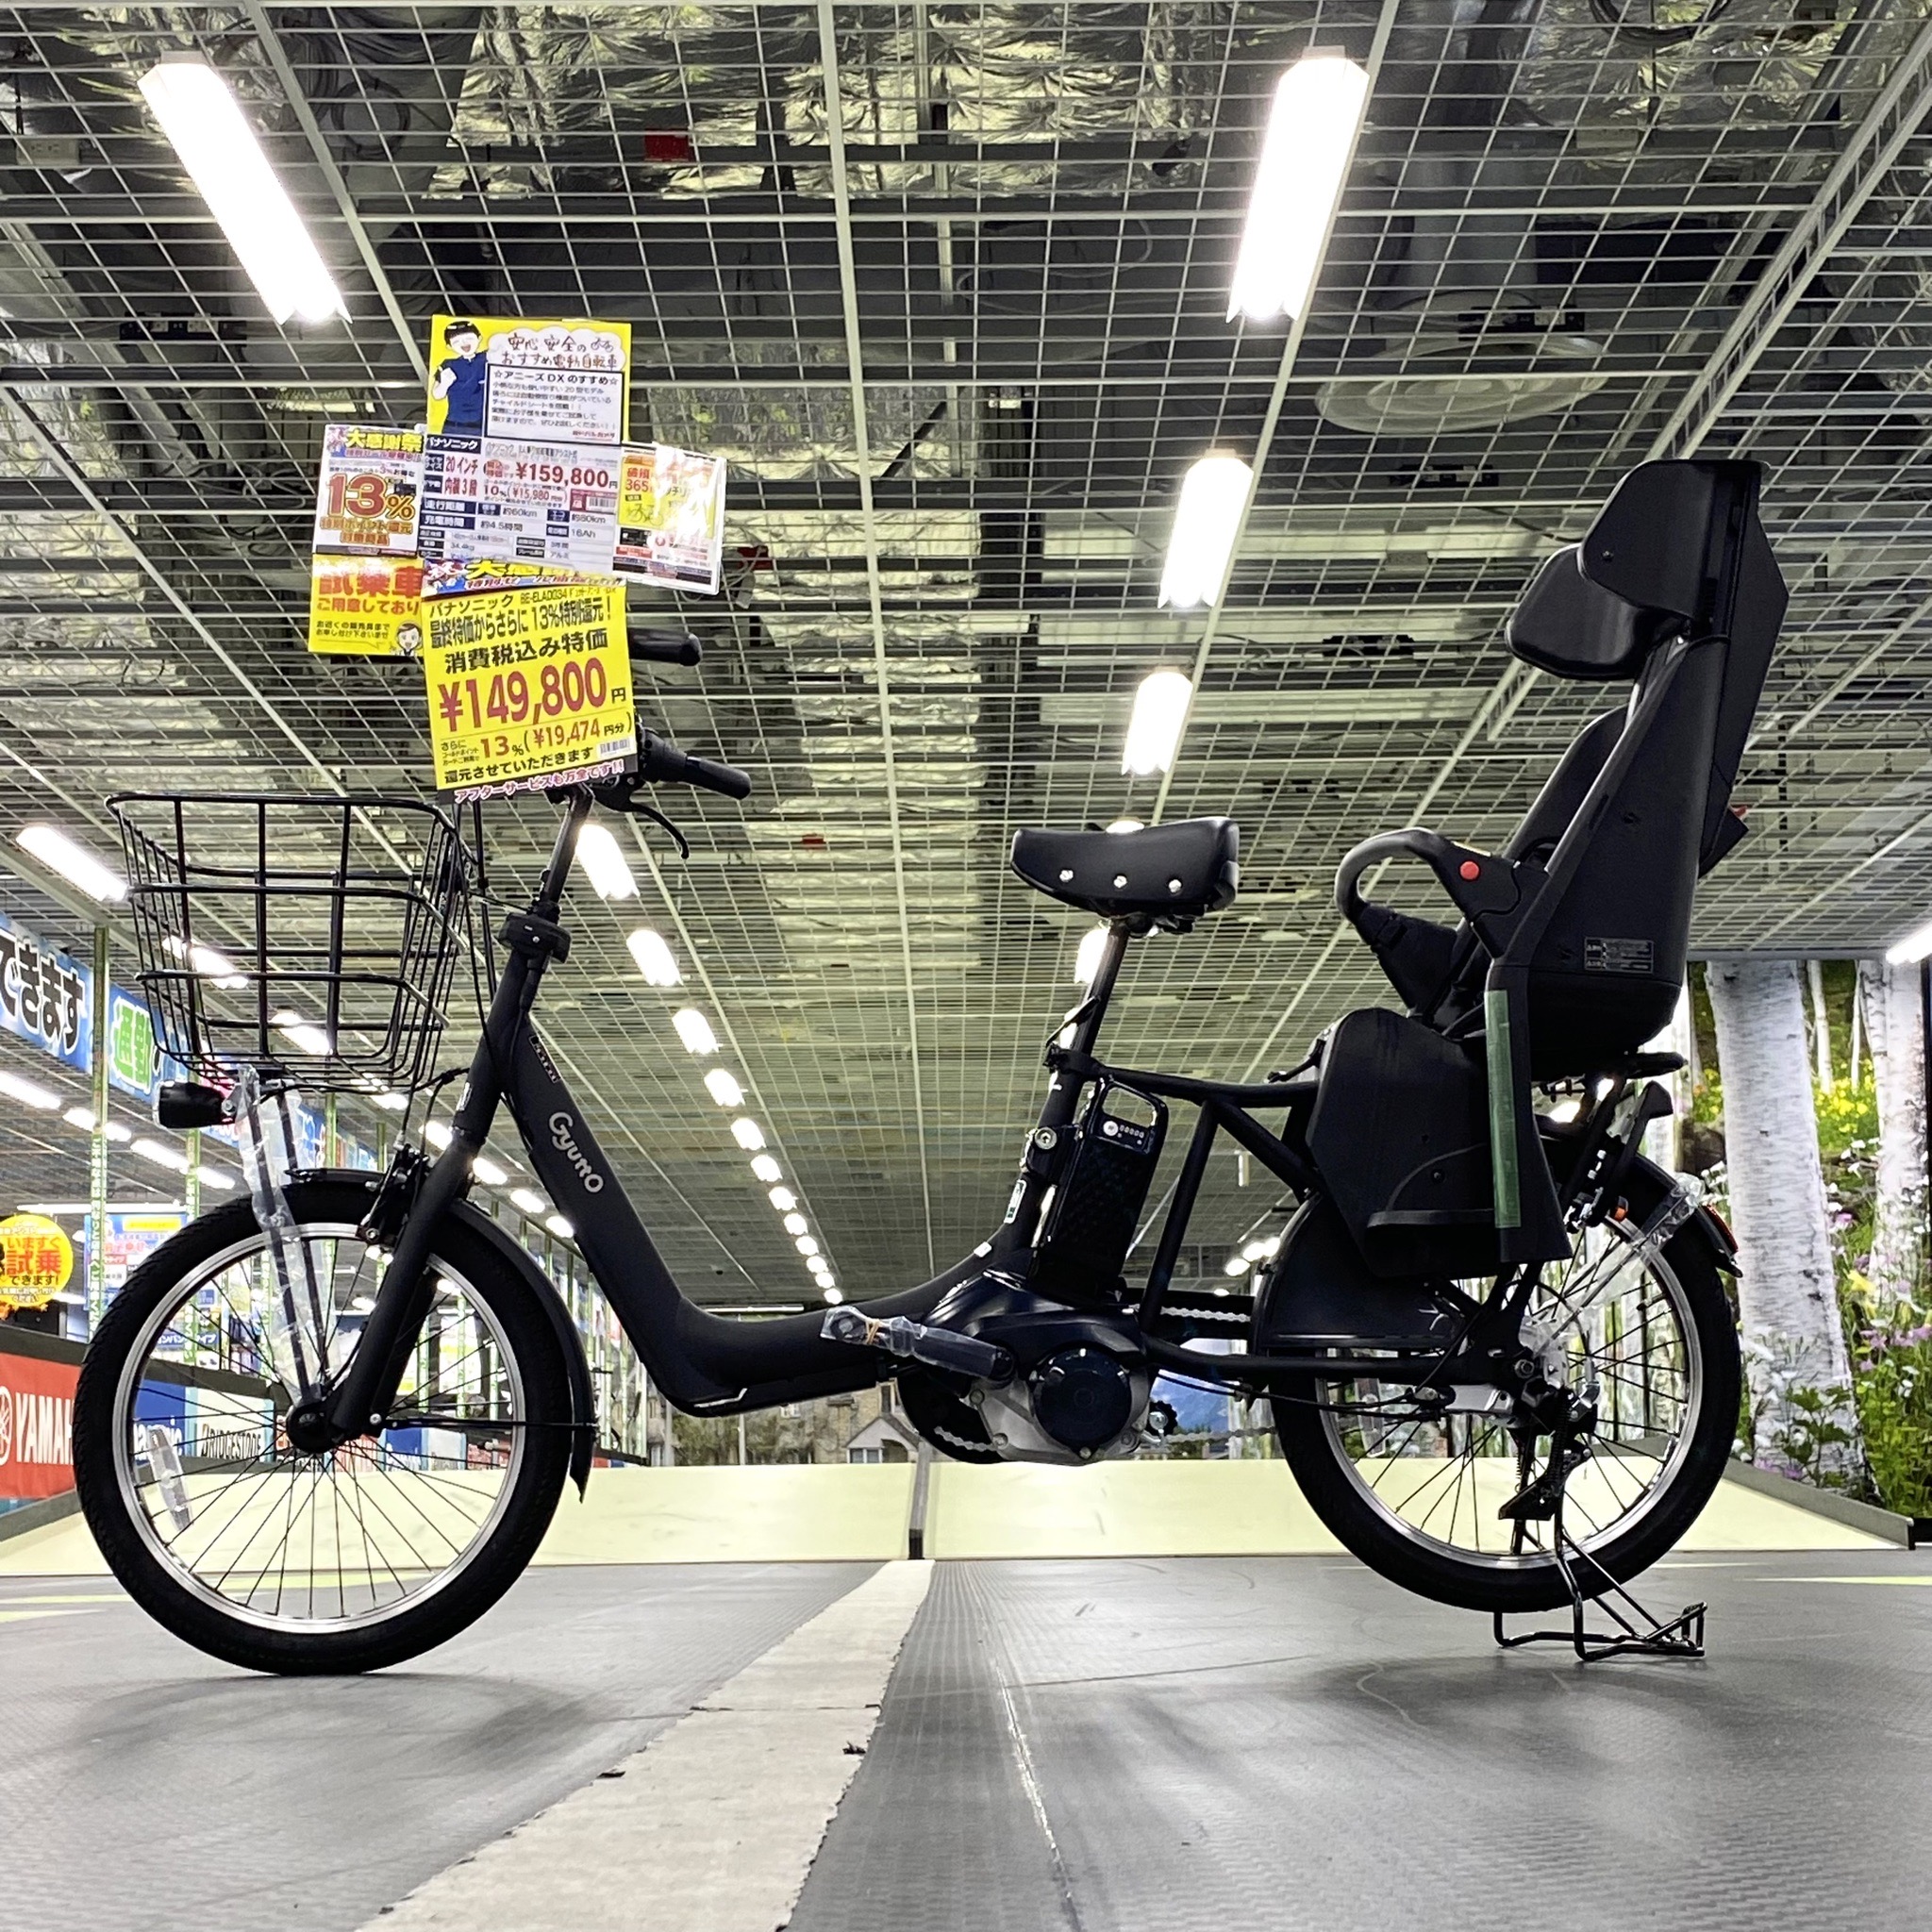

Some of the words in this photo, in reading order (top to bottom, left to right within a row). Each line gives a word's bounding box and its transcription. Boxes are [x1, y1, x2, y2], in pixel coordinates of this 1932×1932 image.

[502, 352, 618, 369] おすすめ電動自転車
[346, 429, 423, 451] 大感謝祭
[327, 473, 416, 520] 13%
[425, 517, 465, 528] 充電時間
[430, 594, 513, 618] パナソニック
[445, 627, 608, 675] 消費税込み特価
[438, 658, 626, 732] ¥149,800円
[441, 739, 467, 751] さらに
[444, 747, 593, 784] 還元させていただきます
[8, 1237, 61, 1248] いますぐ
[6, 1250, 62, 1274] 試乗
[15, 1392, 75, 1465] YAMAH
